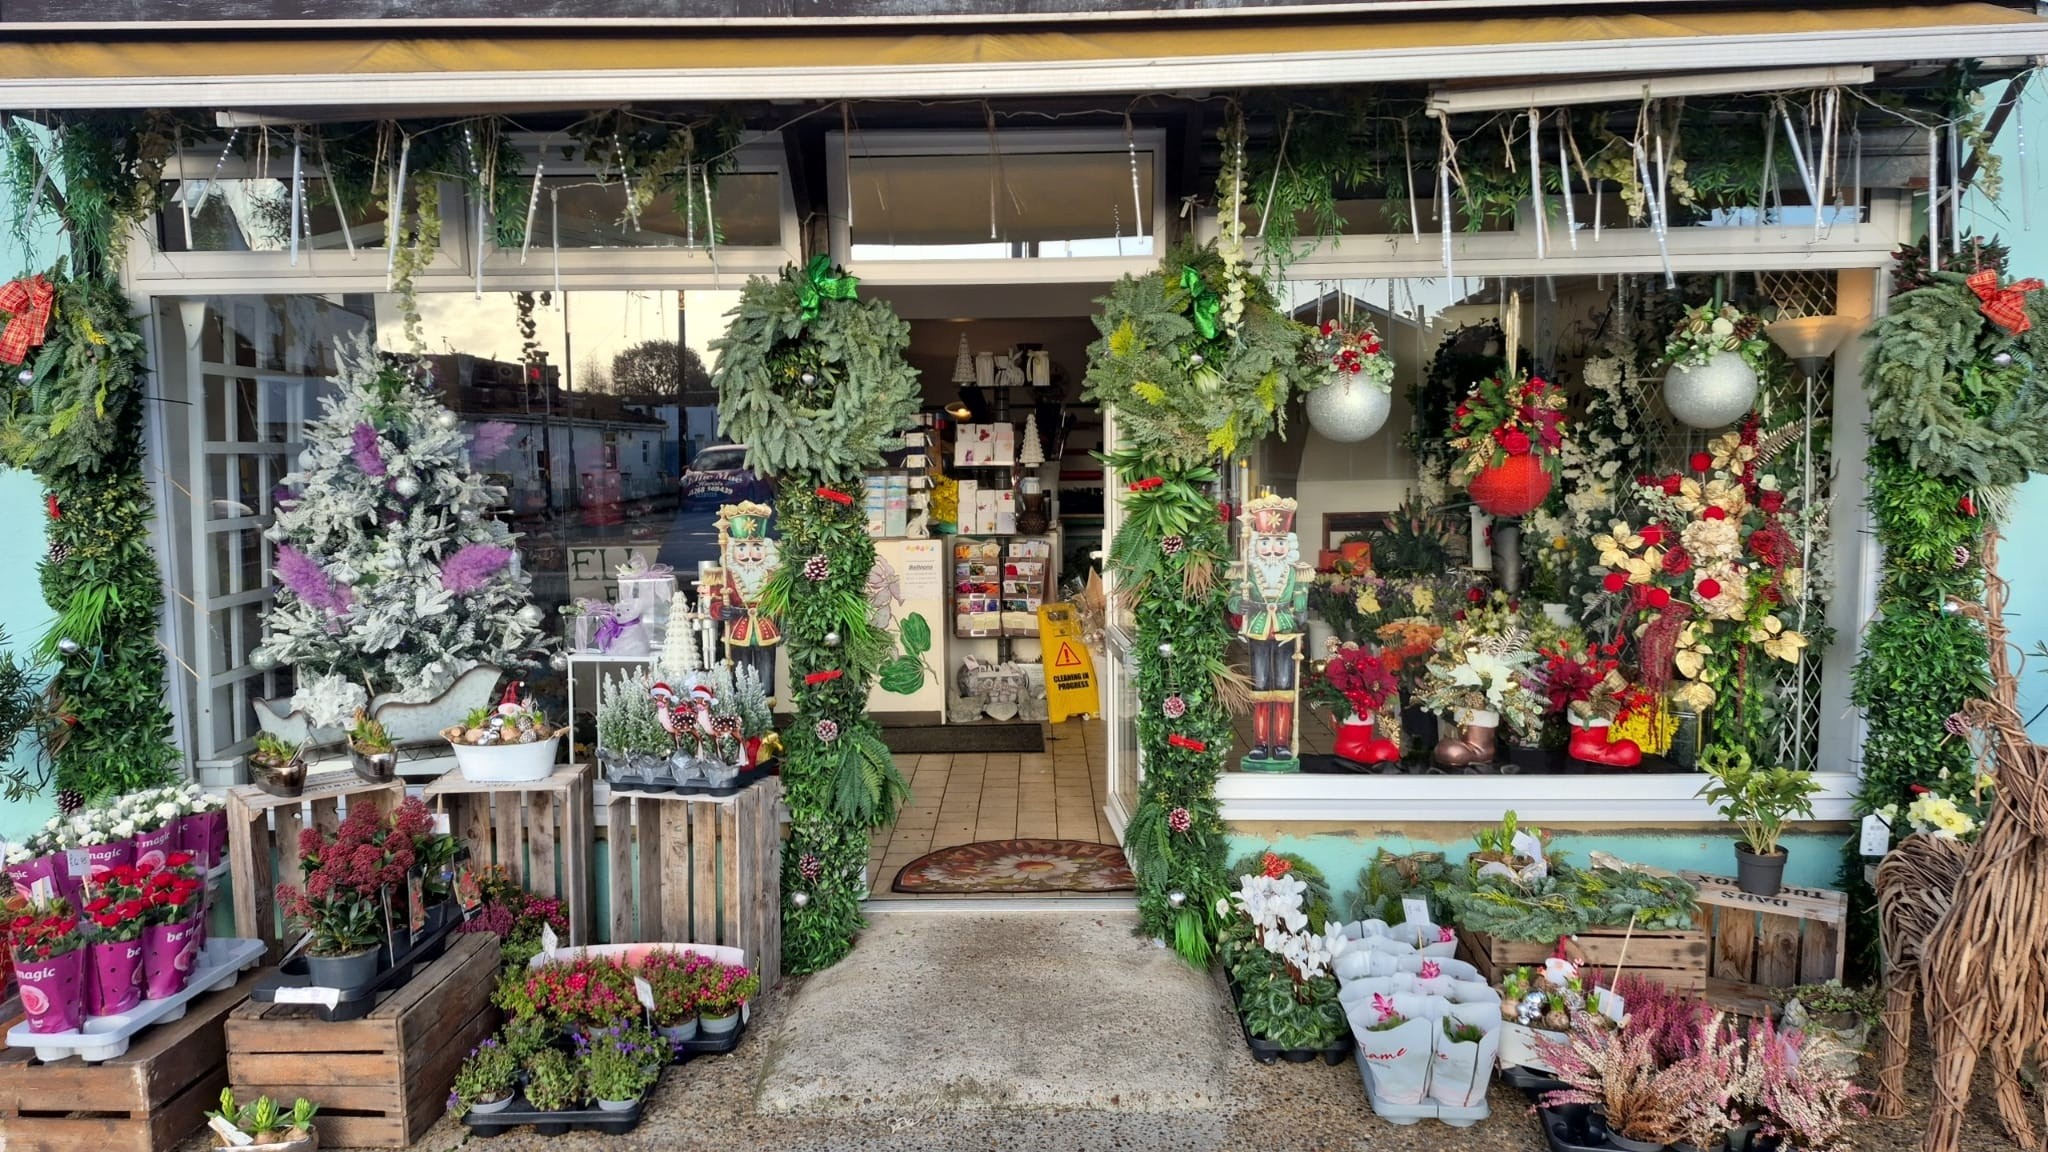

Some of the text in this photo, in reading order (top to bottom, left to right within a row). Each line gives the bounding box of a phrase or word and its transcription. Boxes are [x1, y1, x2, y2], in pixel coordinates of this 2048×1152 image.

[1053, 673, 1082, 683] CLEANING
[1058, 680, 1089, 691] PROGRESS
[1783, 887, 1825, 900] TUC
[167, 932, 183, 943] be
